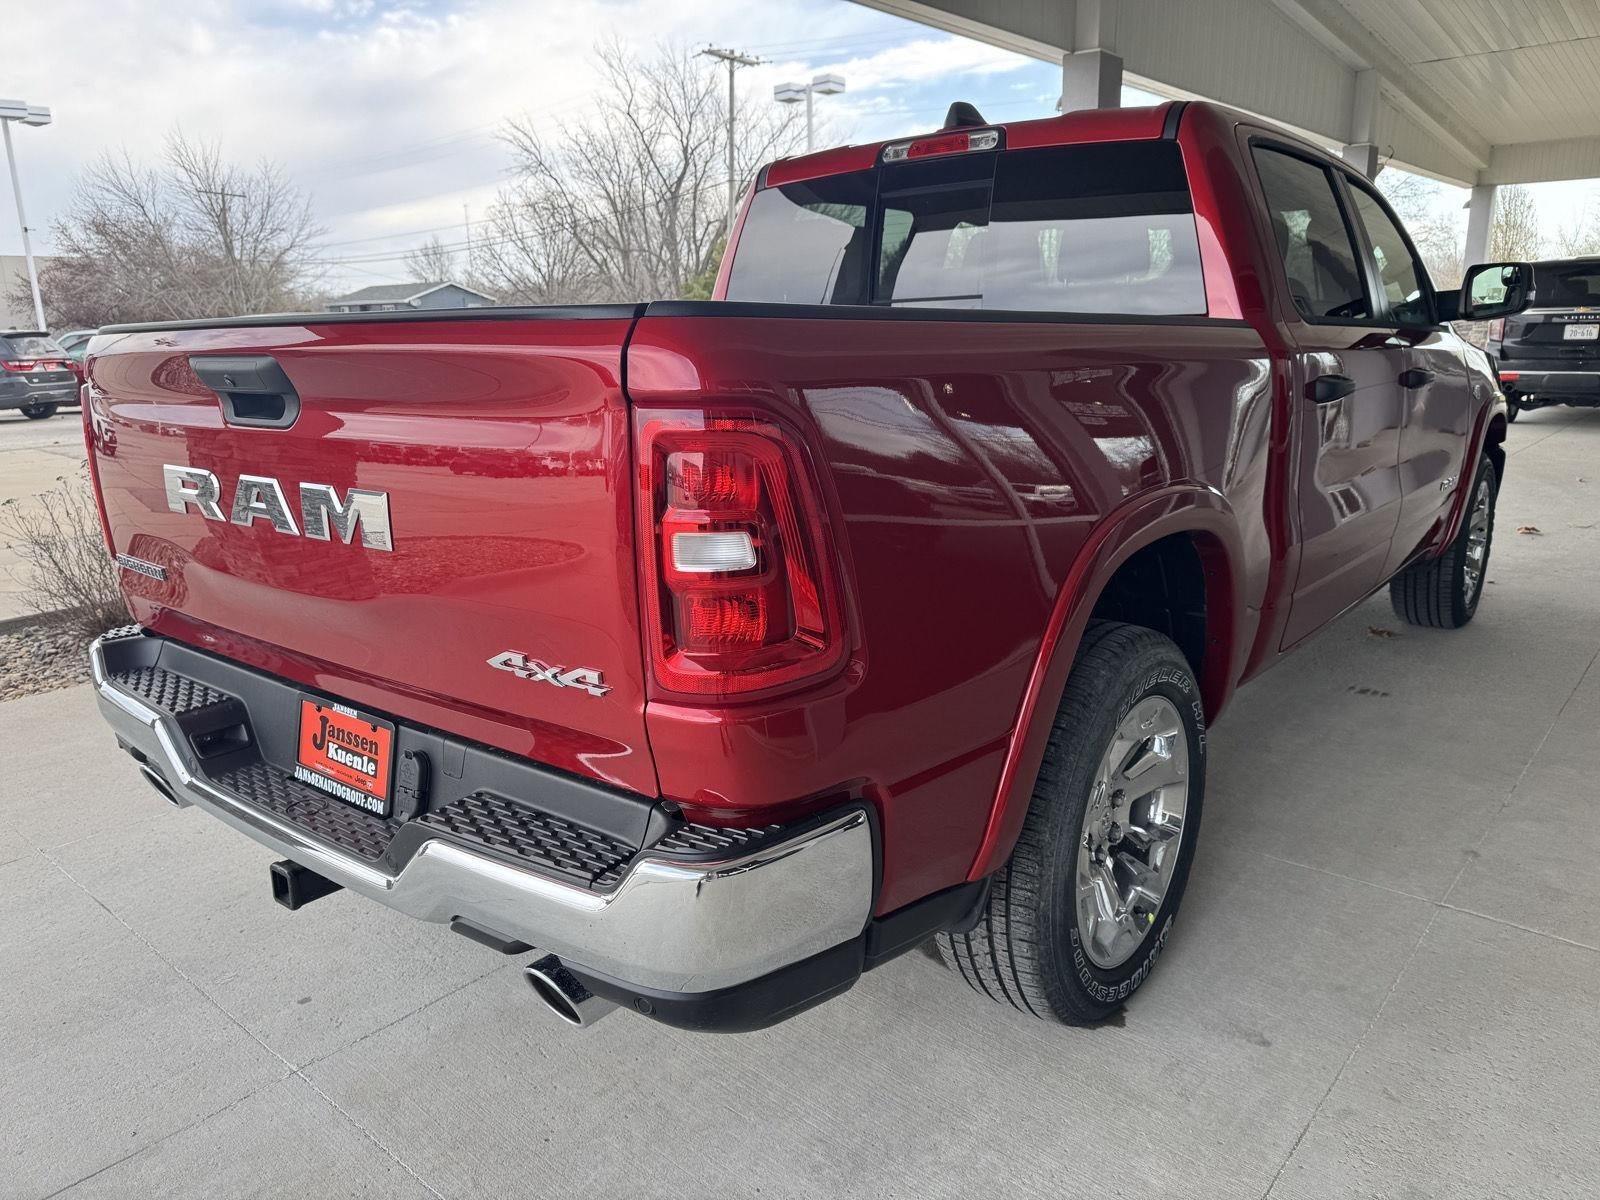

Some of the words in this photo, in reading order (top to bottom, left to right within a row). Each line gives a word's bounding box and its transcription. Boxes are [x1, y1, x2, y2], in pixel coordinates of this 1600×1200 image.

[163, 463, 394, 551] RAM
[312, 715, 379, 756] Janssen
[327, 742, 377, 776] Kuenle
